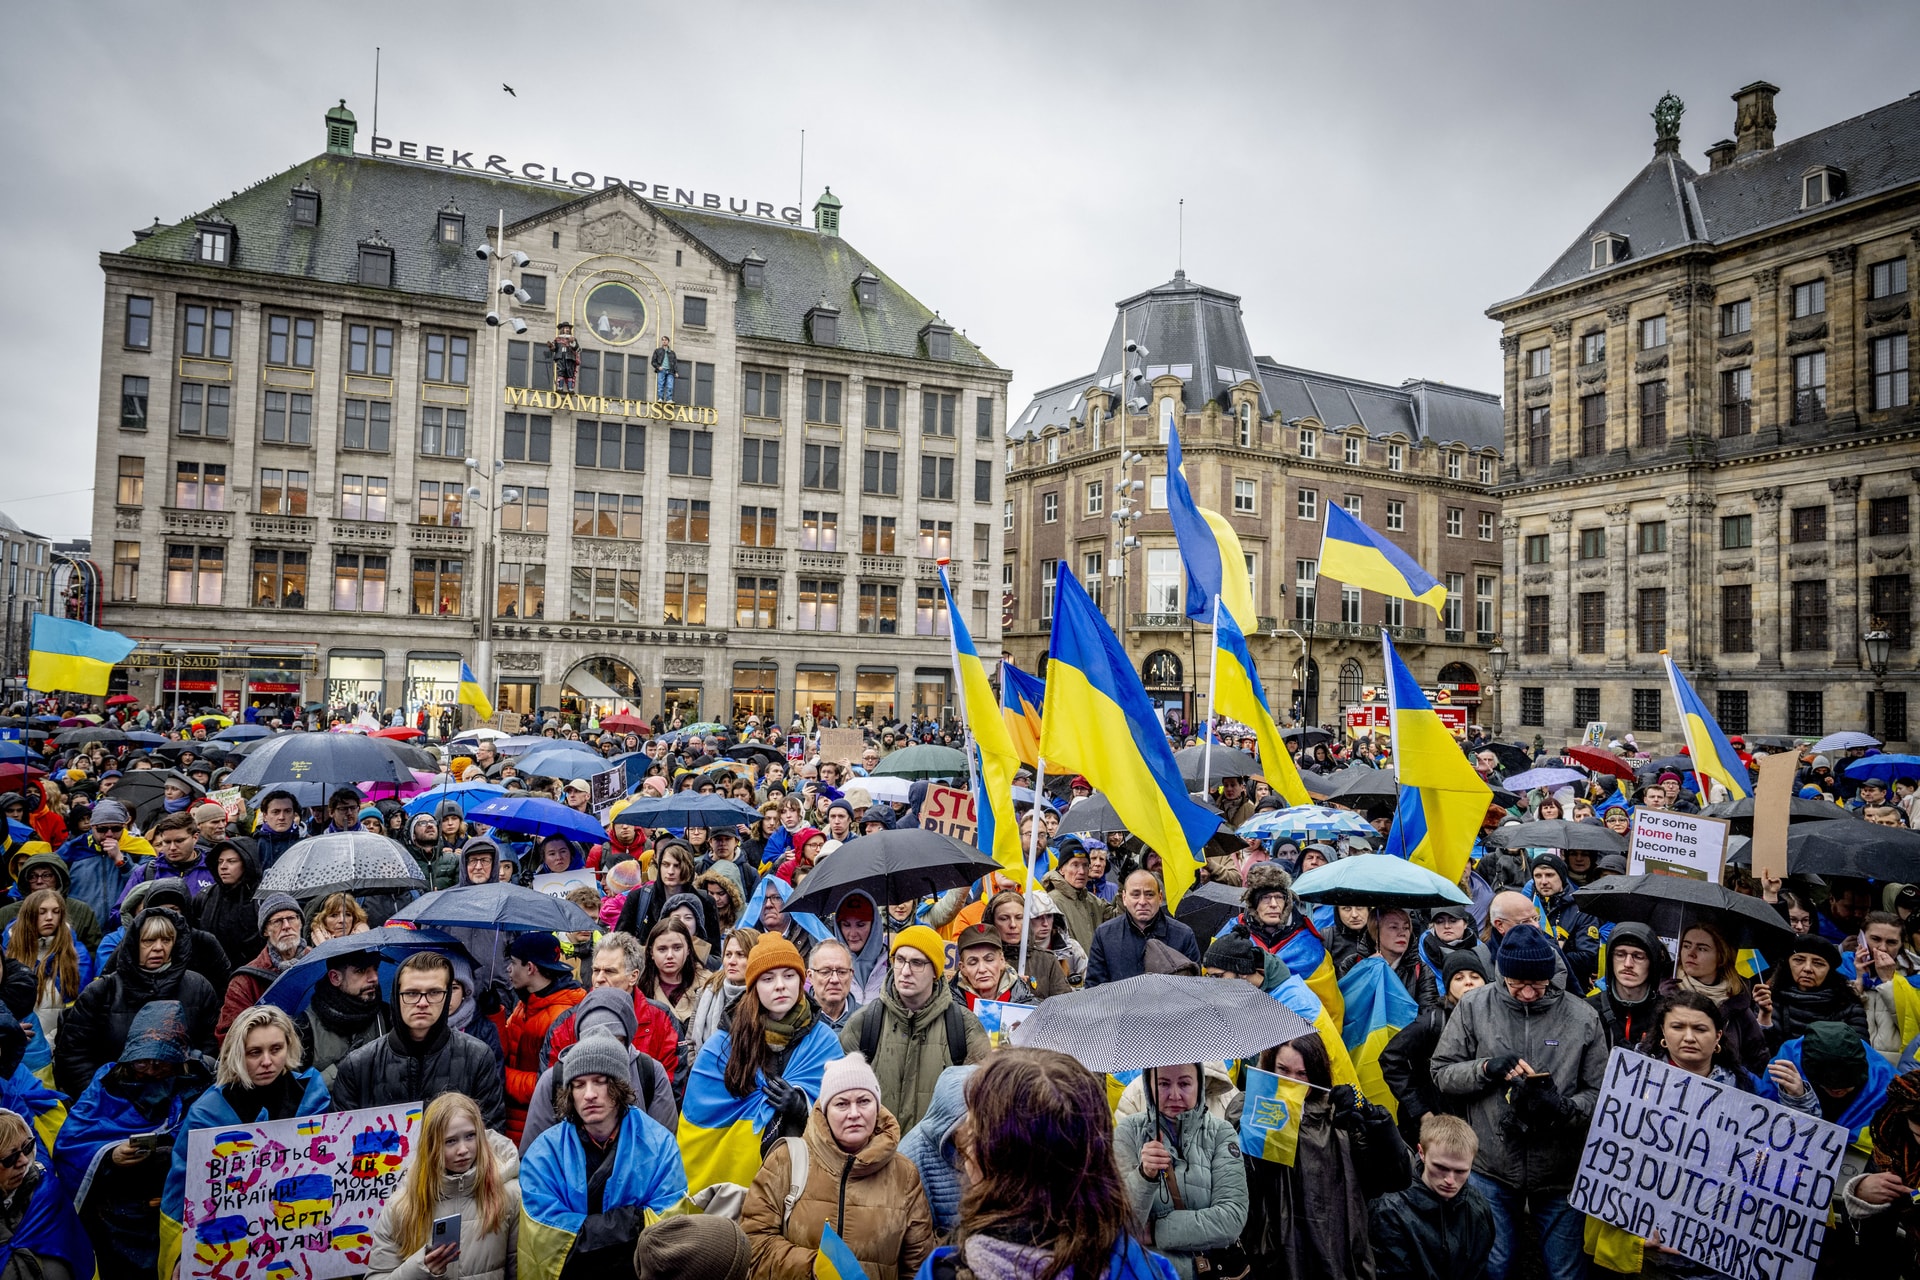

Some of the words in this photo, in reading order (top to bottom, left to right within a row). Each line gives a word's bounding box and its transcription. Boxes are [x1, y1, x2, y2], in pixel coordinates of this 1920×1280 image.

[504, 386, 613, 415] MADAME
[619, 399, 718, 426] TUSSAUD
[492, 625, 530, 636] EEK
[928, 788, 977, 822] STO
[1637, 825, 1673, 841] home
[1675, 832, 1698, 845] has
[1639, 812, 1661, 825] For
[1662, 819, 1697, 832] some
[1636, 838, 1687, 857] become
[1688, 850, 1697, 858] a
[1597, 1094, 1710, 1167] RUSSIA
[1728, 1142, 1835, 1211] KILLED
[1717, 1112, 1739, 1135] in
[1744, 1104, 1842, 1171] 2014
[336, 1156, 375, 1175] ХАЙ
[1586, 1137, 1634, 1181] 193
[1635, 1153, 1735, 1224] DUTCH
[1734, 1190, 1827, 1263] PEOPLE
[1571, 1174, 1655, 1238] RUSSIA
[1669, 1210, 1794, 1280] TERRORIST
[247, 1231, 333, 1259] КАТАМ!
